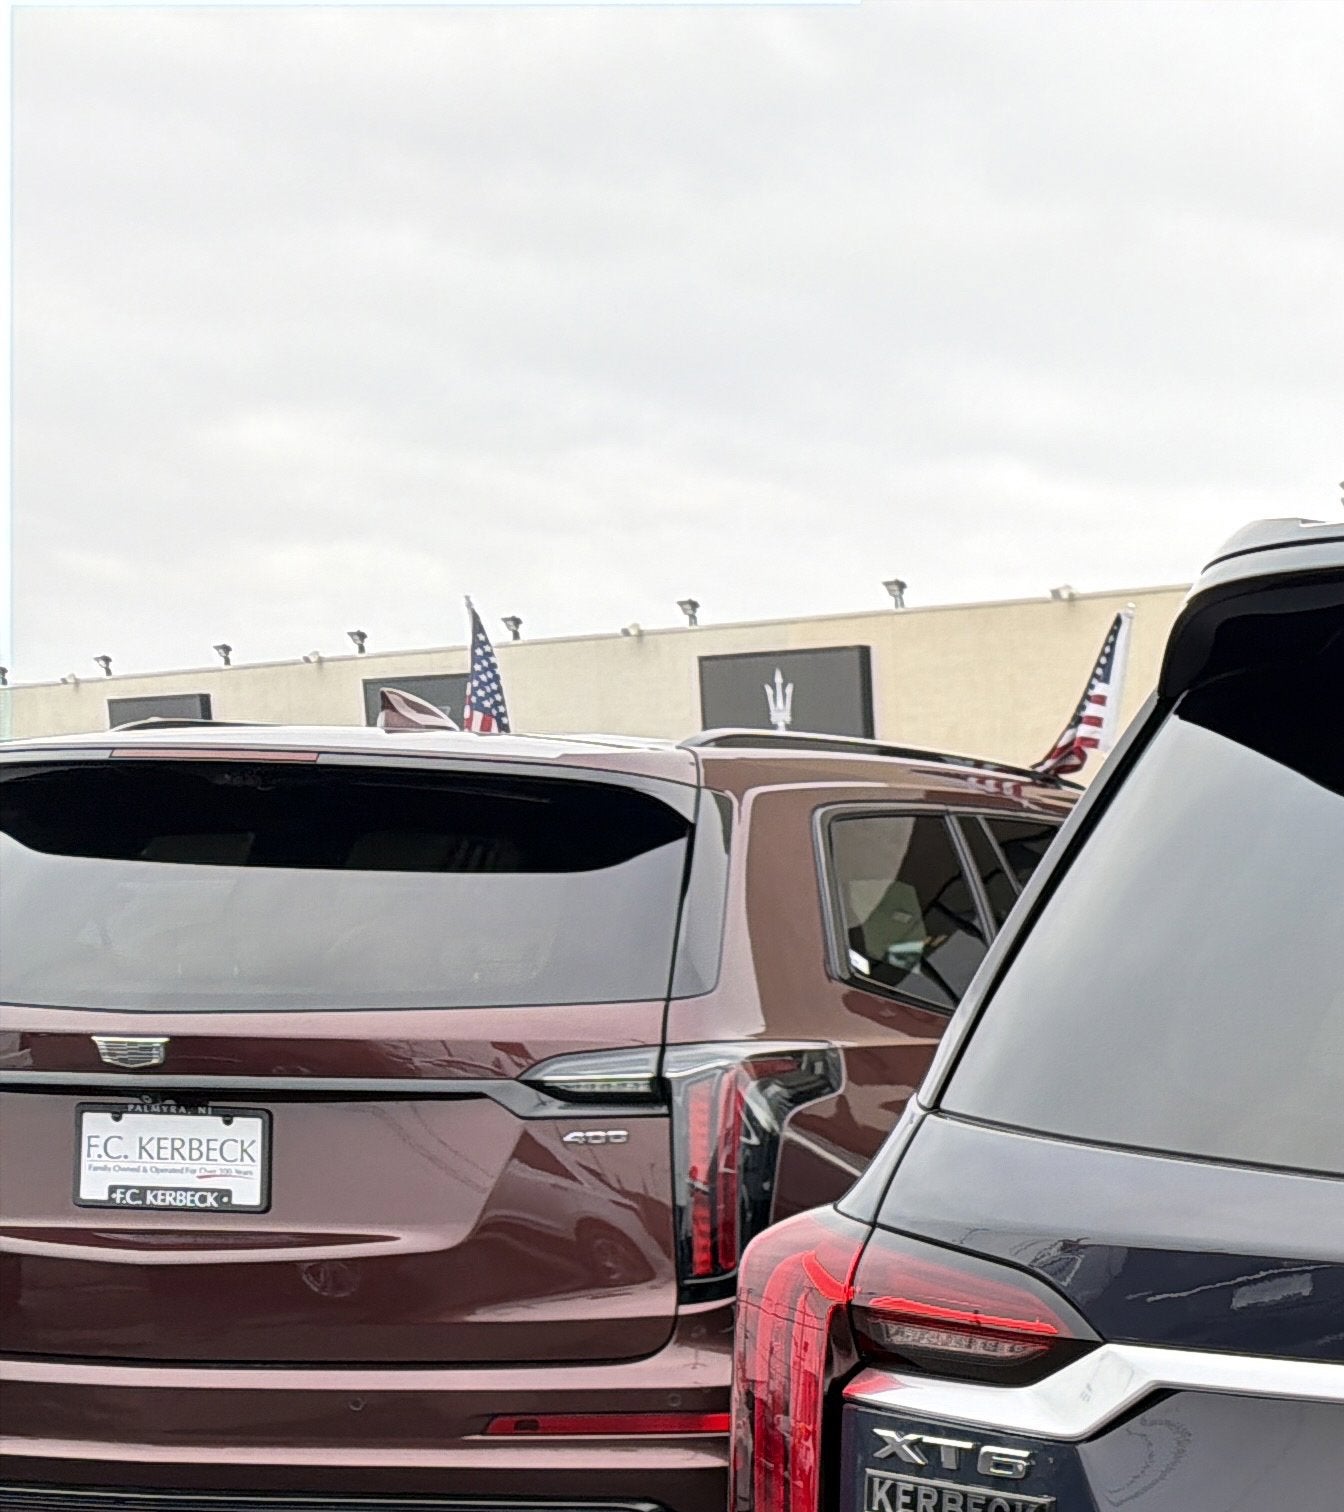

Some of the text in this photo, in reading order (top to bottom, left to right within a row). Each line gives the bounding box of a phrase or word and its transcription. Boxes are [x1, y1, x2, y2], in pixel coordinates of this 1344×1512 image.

[86, 1135, 256, 1163] F.C. KERBECK
[562, 1130, 629, 1144] 400
[115, 1188, 219, 1208] F.C. KERBECK
[872, 1427, 1034, 1479] XT6
